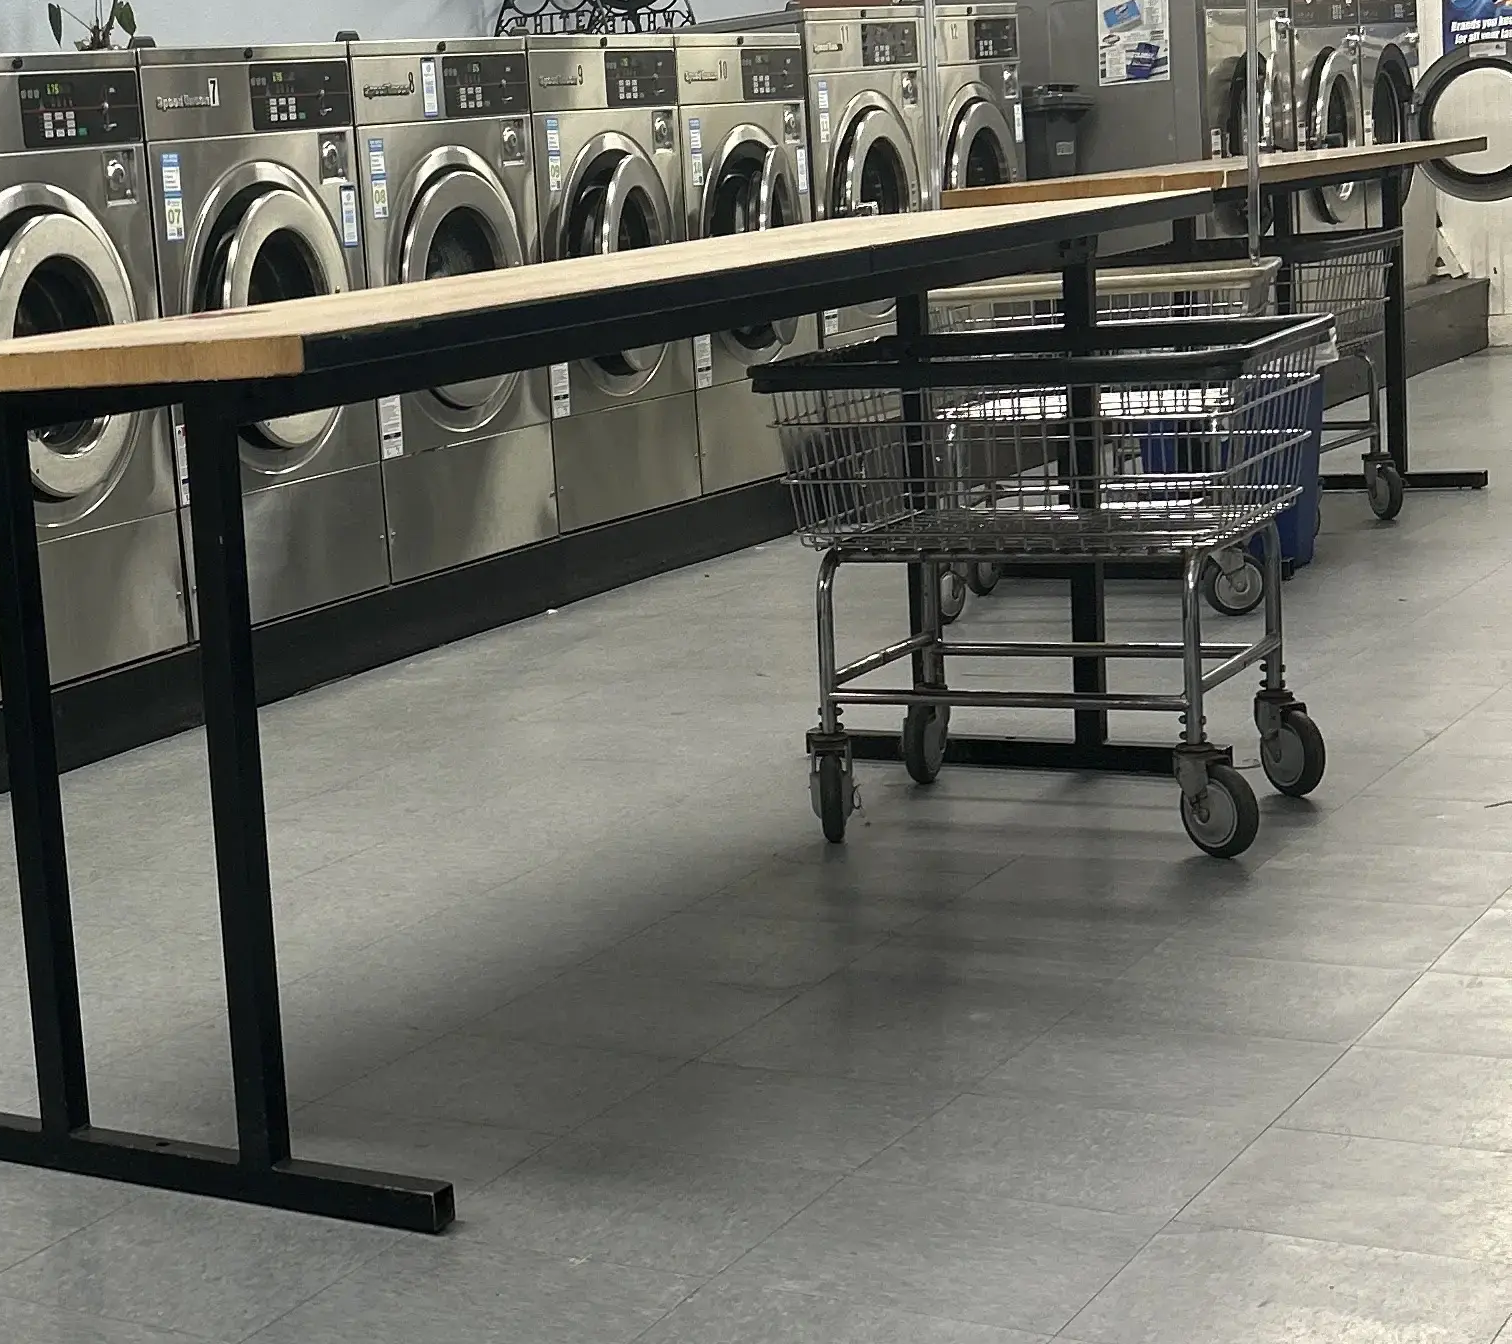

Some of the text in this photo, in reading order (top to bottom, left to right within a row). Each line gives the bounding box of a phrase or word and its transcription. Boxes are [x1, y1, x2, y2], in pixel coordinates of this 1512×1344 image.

[577, 64, 583, 85] 9
[718, 60, 728, 80] 10
[210, 80, 216, 105] 7
[408, 72, 415, 93] 8
[374, 189, 386, 204] 08
[167, 208, 181, 225] 07
